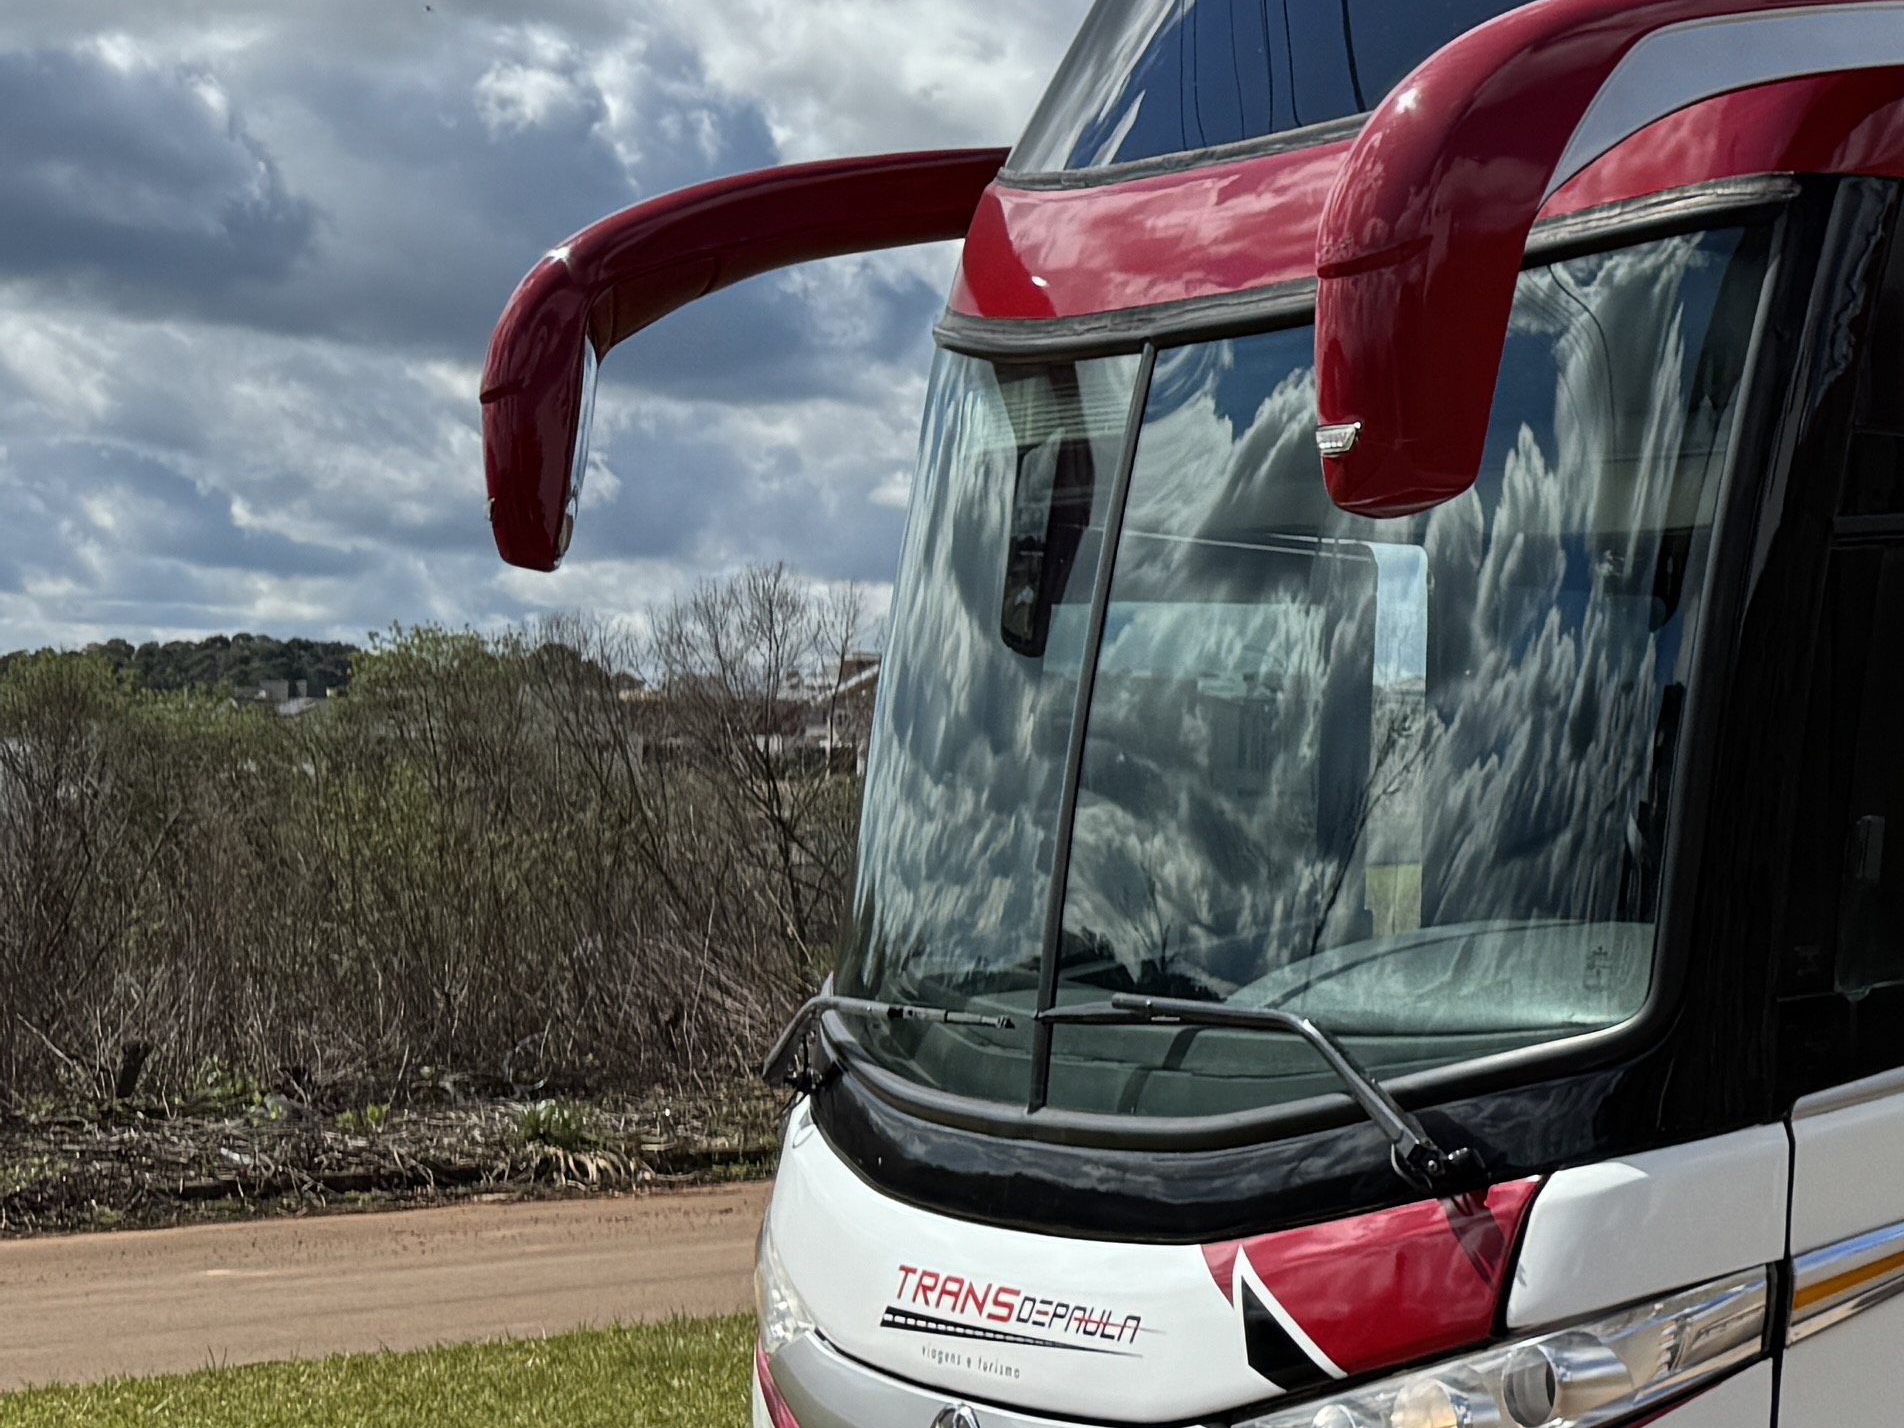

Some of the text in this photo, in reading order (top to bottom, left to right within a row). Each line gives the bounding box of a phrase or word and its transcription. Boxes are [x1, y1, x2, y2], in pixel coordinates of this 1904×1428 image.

[921, 1342, 1021, 1380] viagens e turismo
